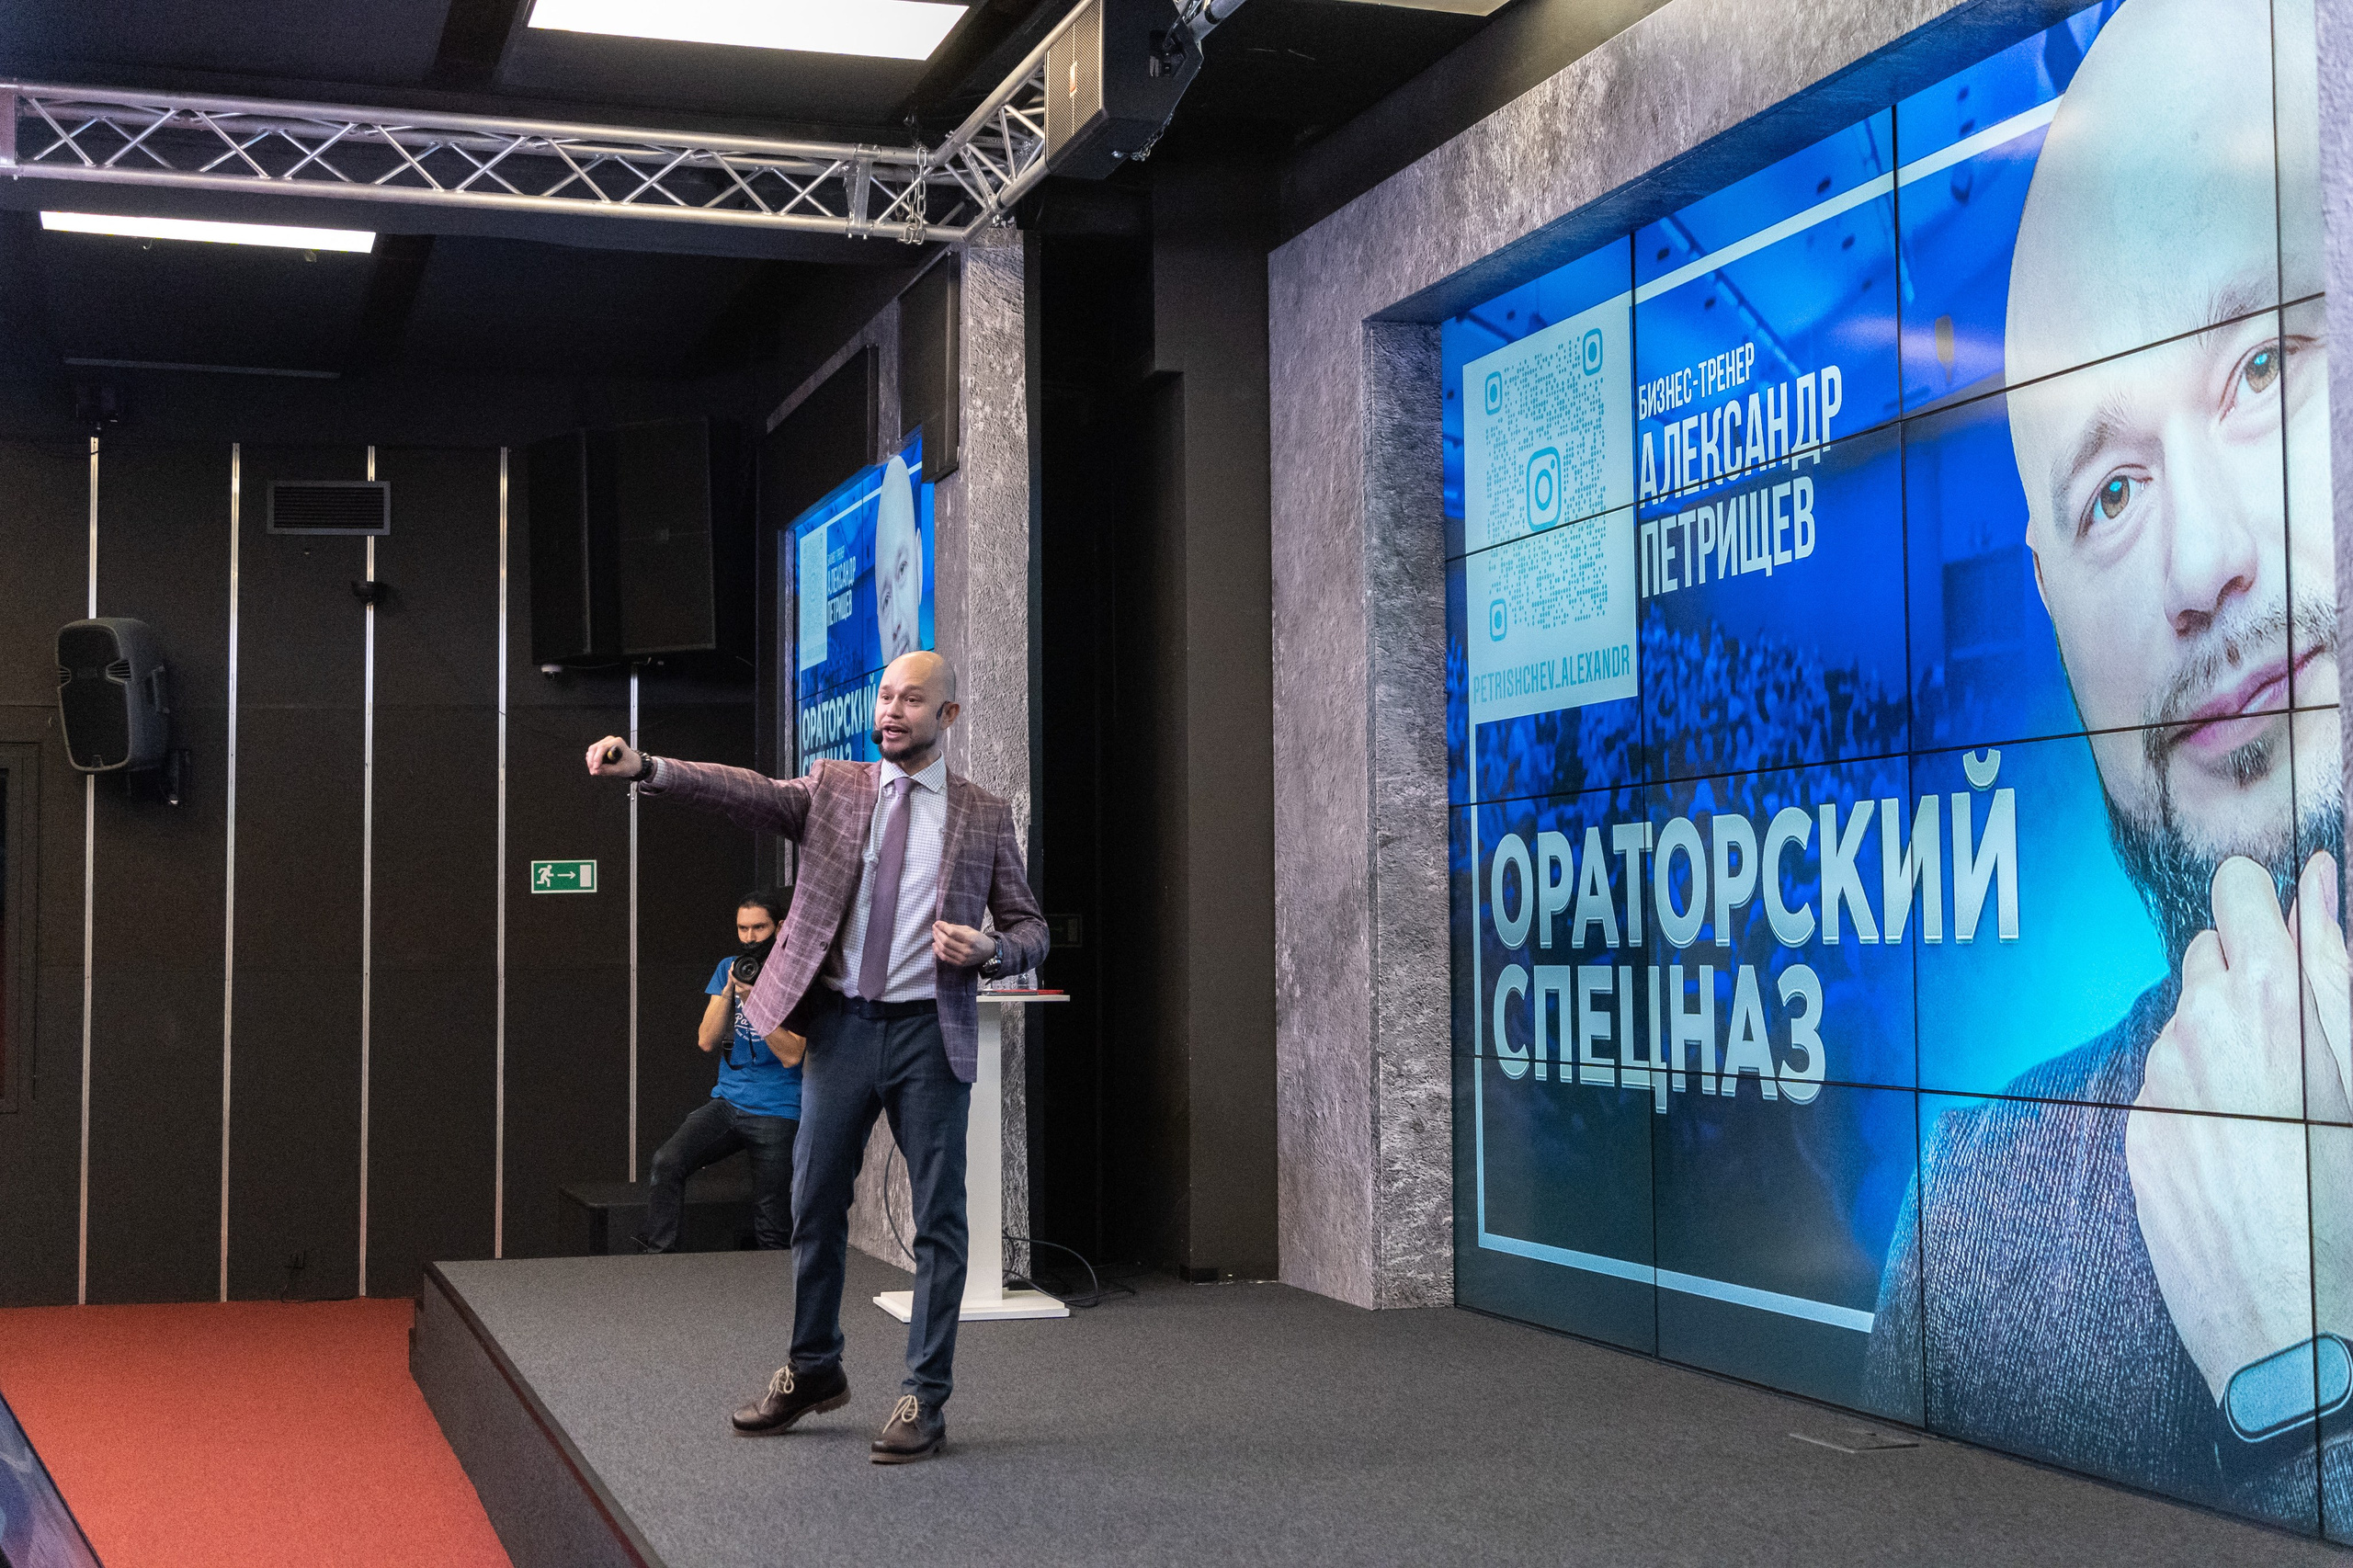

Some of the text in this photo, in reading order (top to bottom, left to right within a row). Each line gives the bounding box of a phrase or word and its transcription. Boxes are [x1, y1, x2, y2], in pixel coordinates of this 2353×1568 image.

[1639, 342, 1755, 421] БИЗНЕС-ТРЕНЕР
[1639, 365, 1843, 507] АЛЕКСАНДР
[1640, 475, 1815, 598] ПЕТРИЩЕВ
[1473, 643, 1630, 704] PETRISHCHEV_ALEXANDR
[1492, 749, 2018, 949] ОРАТОРСКИЙ
[1495, 963, 1826, 1114] СПЕЦНАЗ
